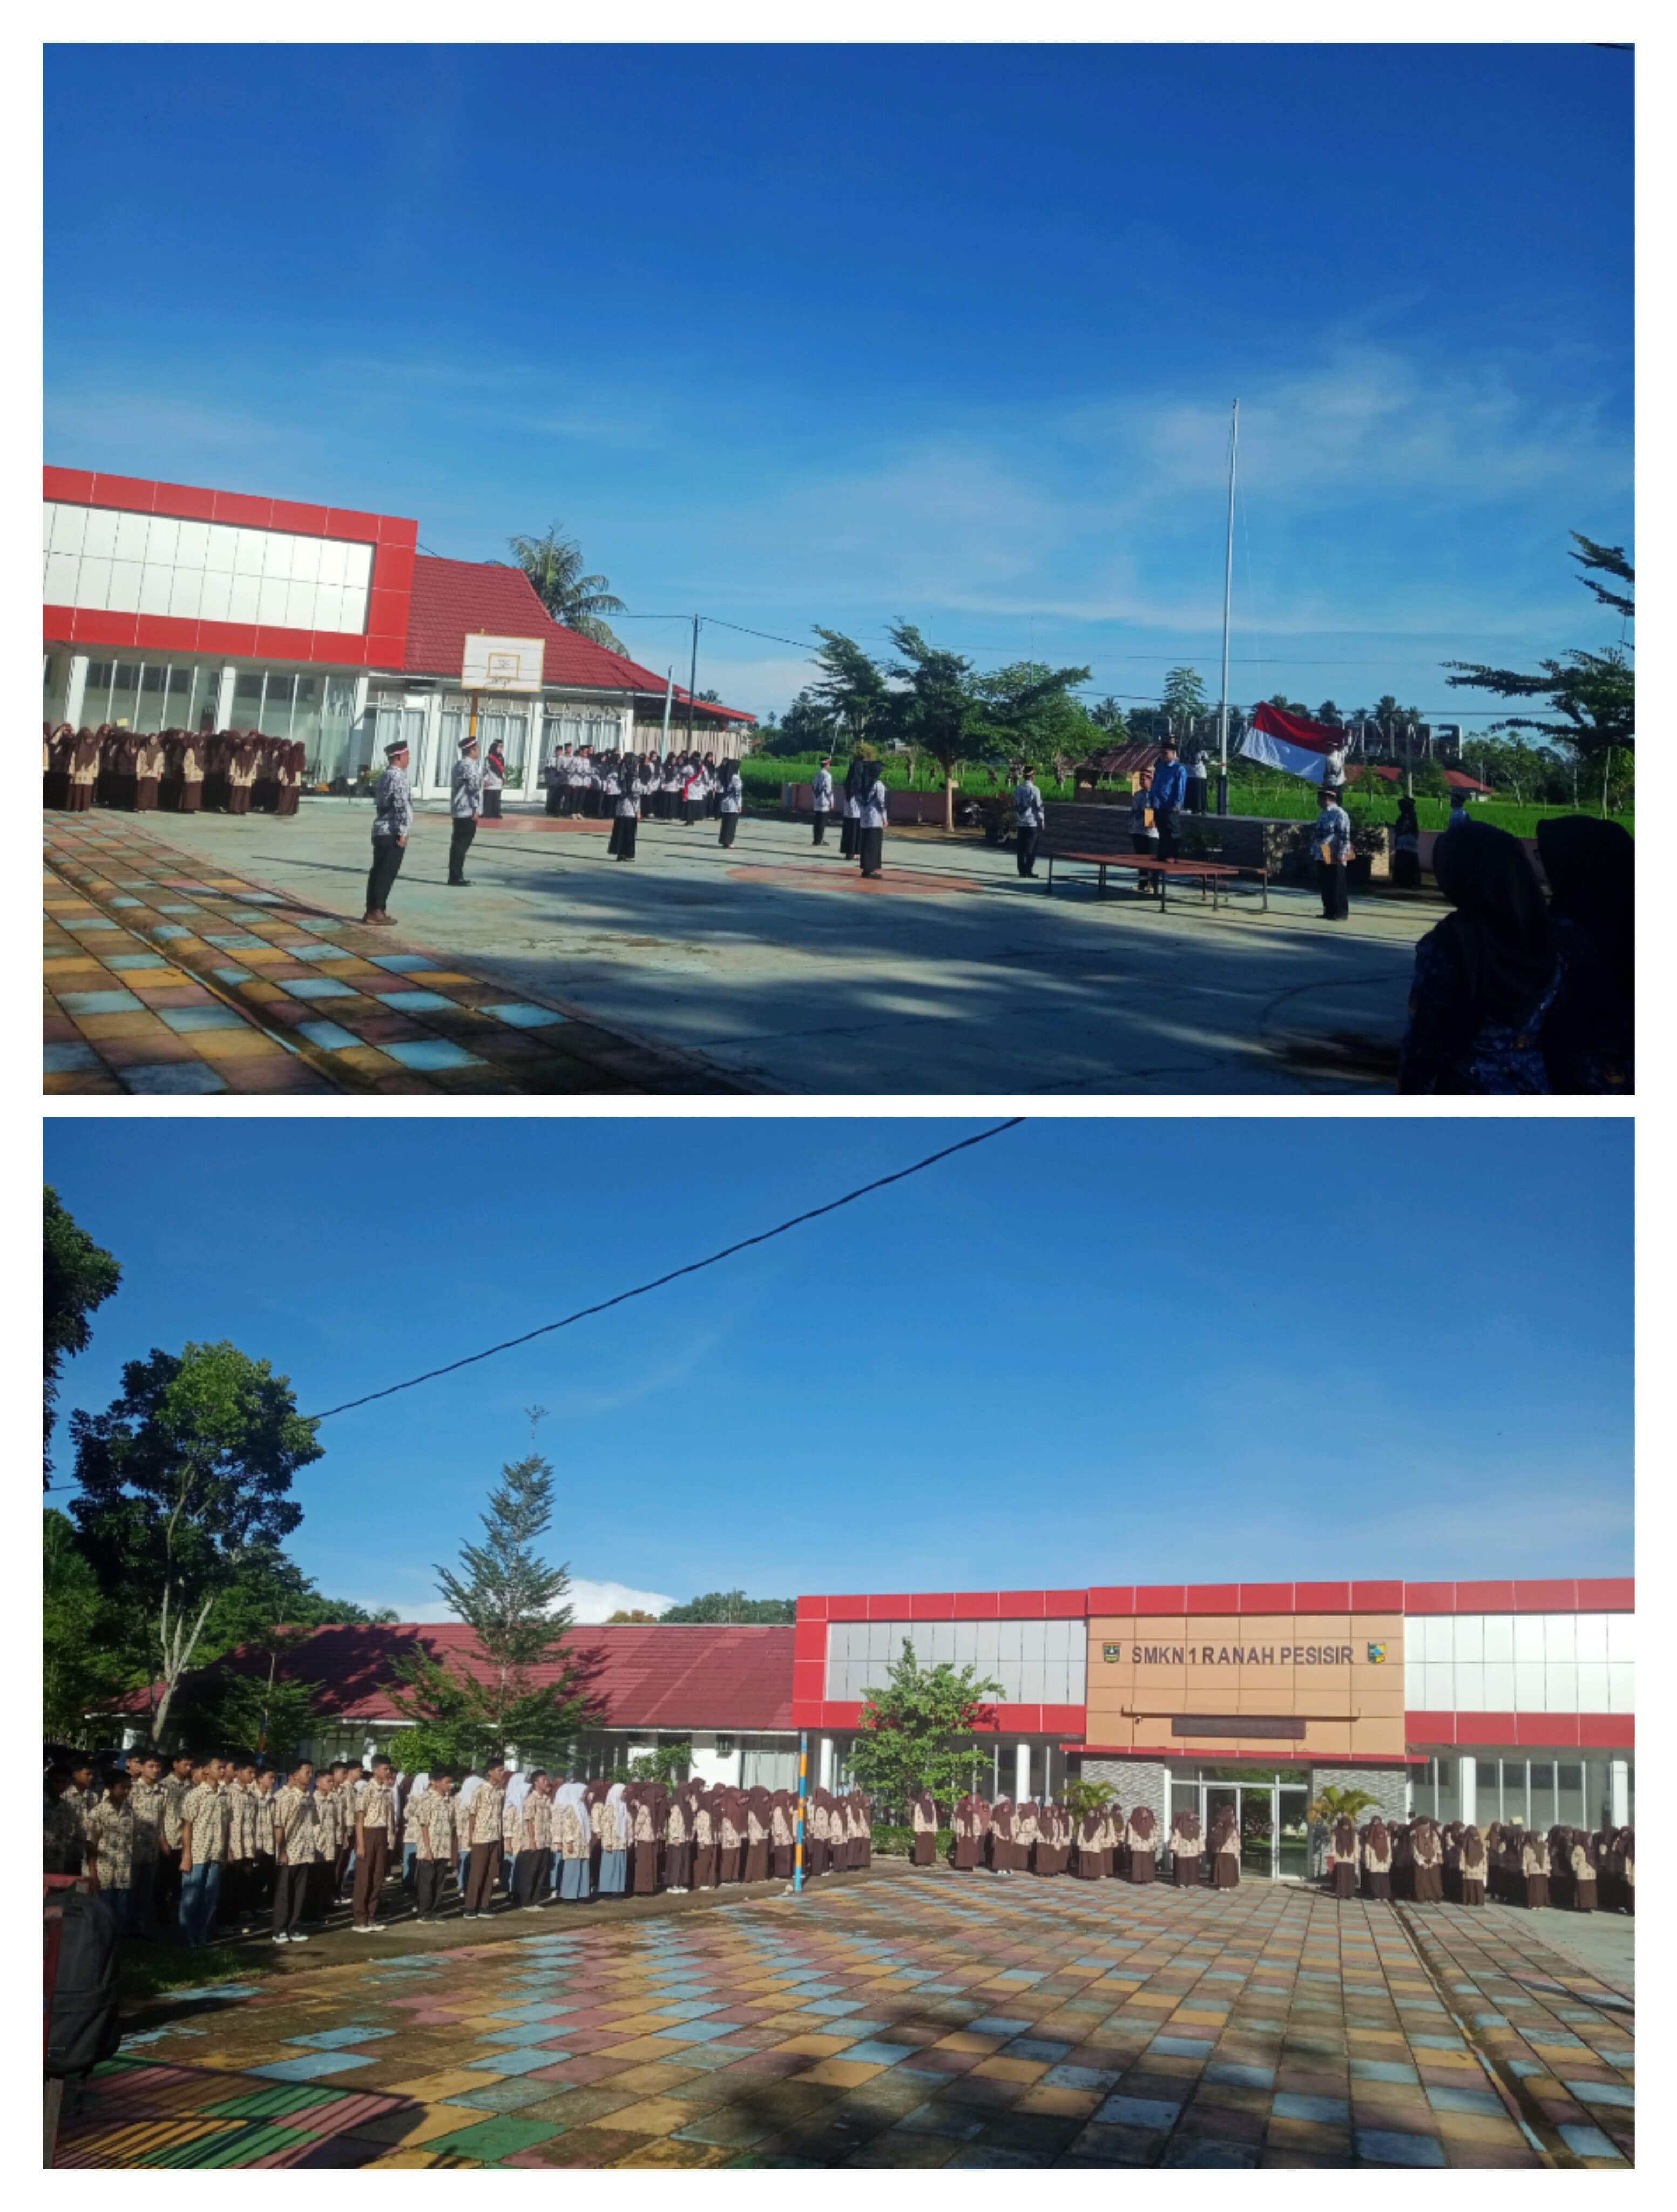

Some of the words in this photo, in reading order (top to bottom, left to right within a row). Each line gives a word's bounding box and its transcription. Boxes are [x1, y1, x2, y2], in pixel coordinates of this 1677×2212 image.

[1132, 1645, 1184, 1664] SMKN
[1188, 1646, 1196, 1664] 1
[1202, 1646, 1274, 1665] RANAH
[1280, 1646, 1354, 1665] PESISIR
